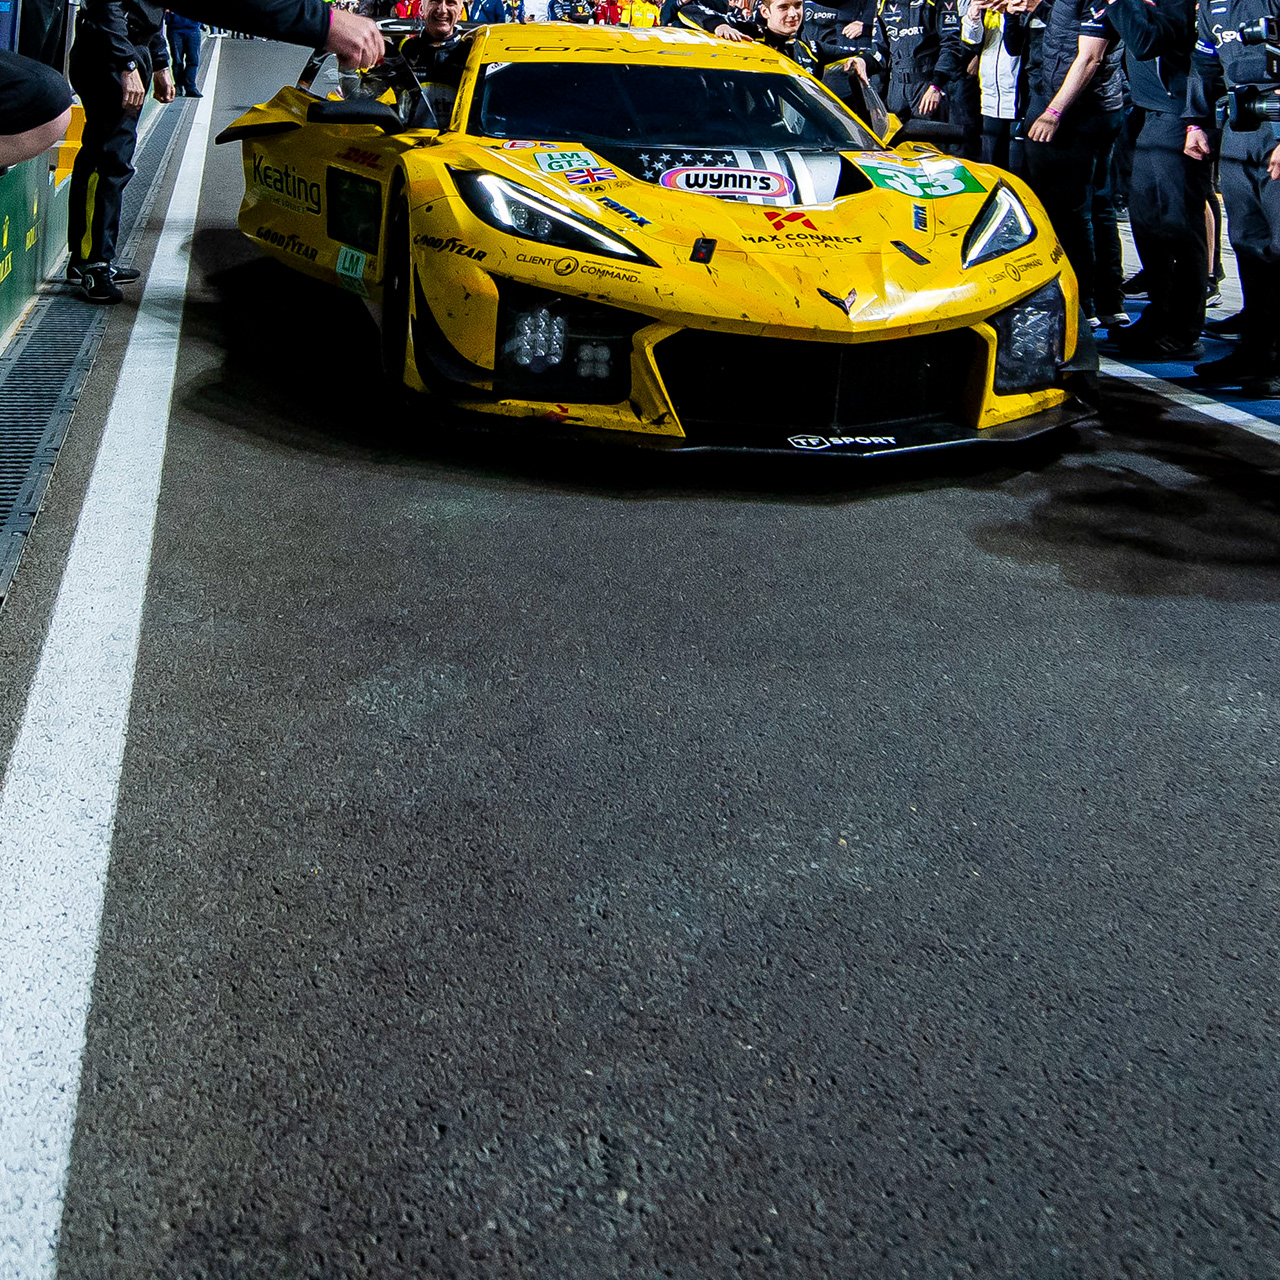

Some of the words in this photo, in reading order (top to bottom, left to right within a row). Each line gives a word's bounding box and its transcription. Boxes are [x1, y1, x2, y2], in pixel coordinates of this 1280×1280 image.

[339, 147, 382, 169] DHL
[547, 152, 582, 161] LM
[547, 160, 592, 171] GT3
[253, 153, 321, 215] Keating
[685, 172, 771, 191] wynn's
[877, 169, 966, 197] 33
[256, 227, 319, 261] GOODYEAR
[742, 235, 780, 243] MAX
[786, 233, 863, 244] CONNECT
[776, 243, 842, 251] DIGITAL
[413, 234, 488, 262] GOODYEAR
[341, 250, 361, 274] LM
[516, 253, 553, 266] CLIENT
[581, 265, 638, 283] COMMAND
[987, 271, 1007, 284] CLIENT
[794, 438, 820, 446] TF
[829, 437, 896, 445] SPORT
